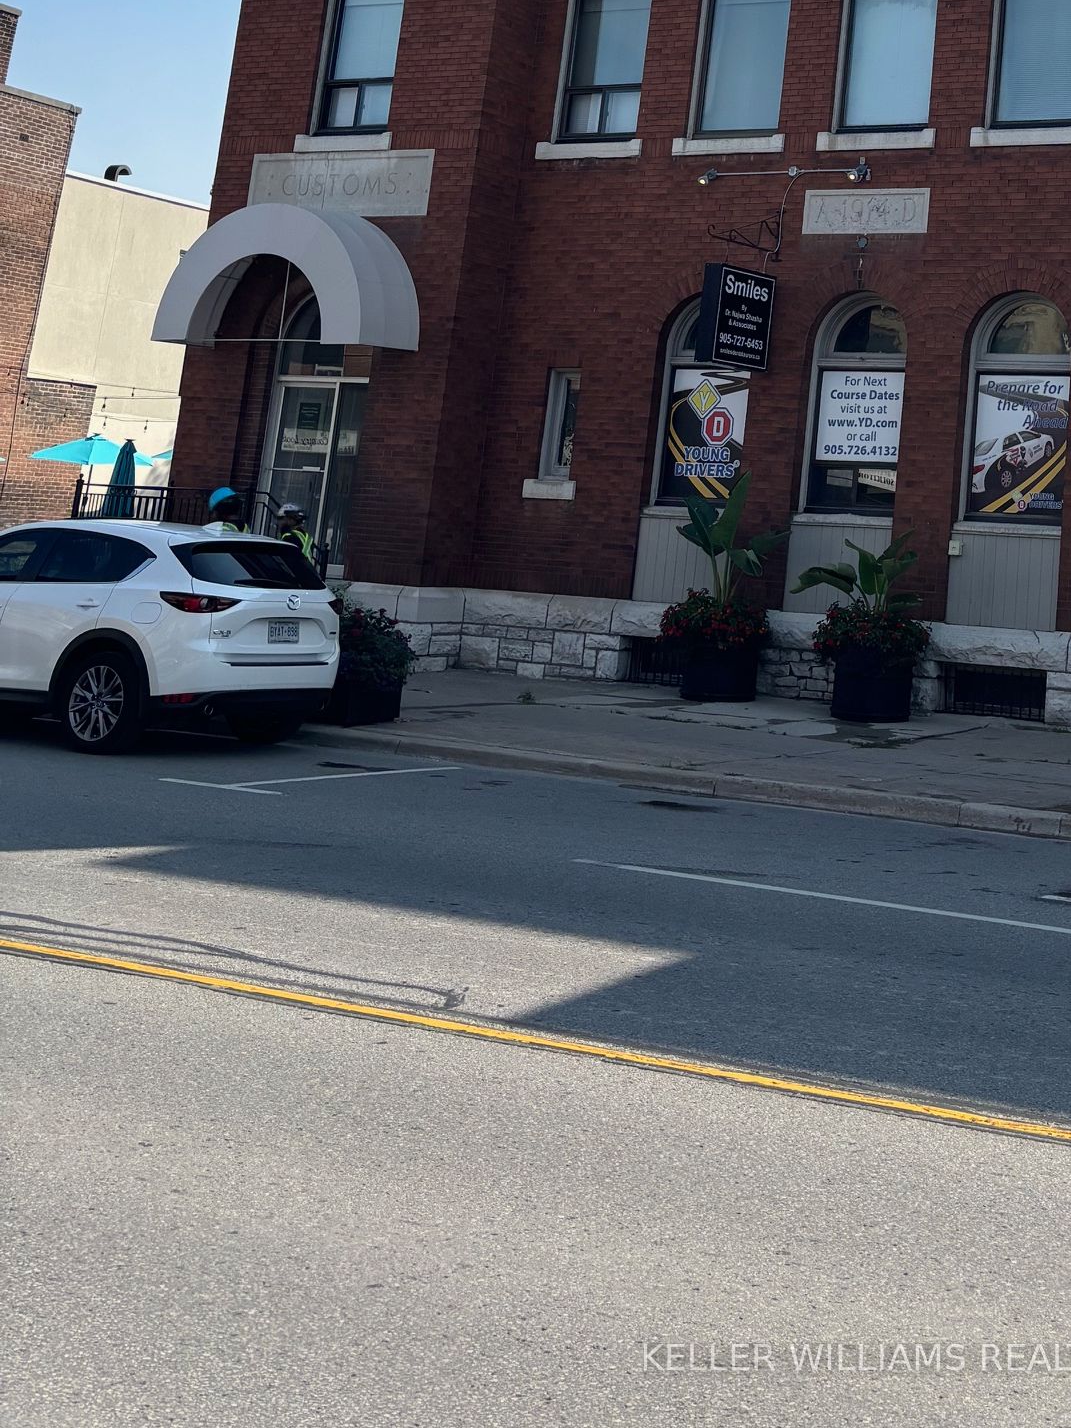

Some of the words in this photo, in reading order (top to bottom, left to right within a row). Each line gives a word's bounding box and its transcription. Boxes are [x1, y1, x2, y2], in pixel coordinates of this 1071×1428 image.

[281, 173, 398, 196] CUSTOMS
[725, 274, 769, 302] Smiles
[741, 304, 748, 313] By
[732, 319, 757, 331] Associates
[719, 332, 764, 350] 905-727-6453
[844, 376, 862, 387] For
[863, 376, 887, 387] Next
[830, 389, 867, 400] Course
[869, 390, 900, 401] Dates
[986, 380, 1041, 397] Prepare
[1043, 380, 1065, 395] for
[840, 403, 861, 414] visit
[863, 405, 875, 414] us
[876, 405, 888, 414] at
[997, 399, 1020, 412] the
[1022, 398, 1059, 412] Road
[712, 416, 725, 437] D
[827, 417, 898, 429] www.YD.com
[1021, 414, 1069, 429] Ahead
[846, 433, 858, 442] or
[859, 431, 877, 442] call
[684, 446, 731, 462] YOUNG
[823, 444, 898, 456] 905.726.4132
